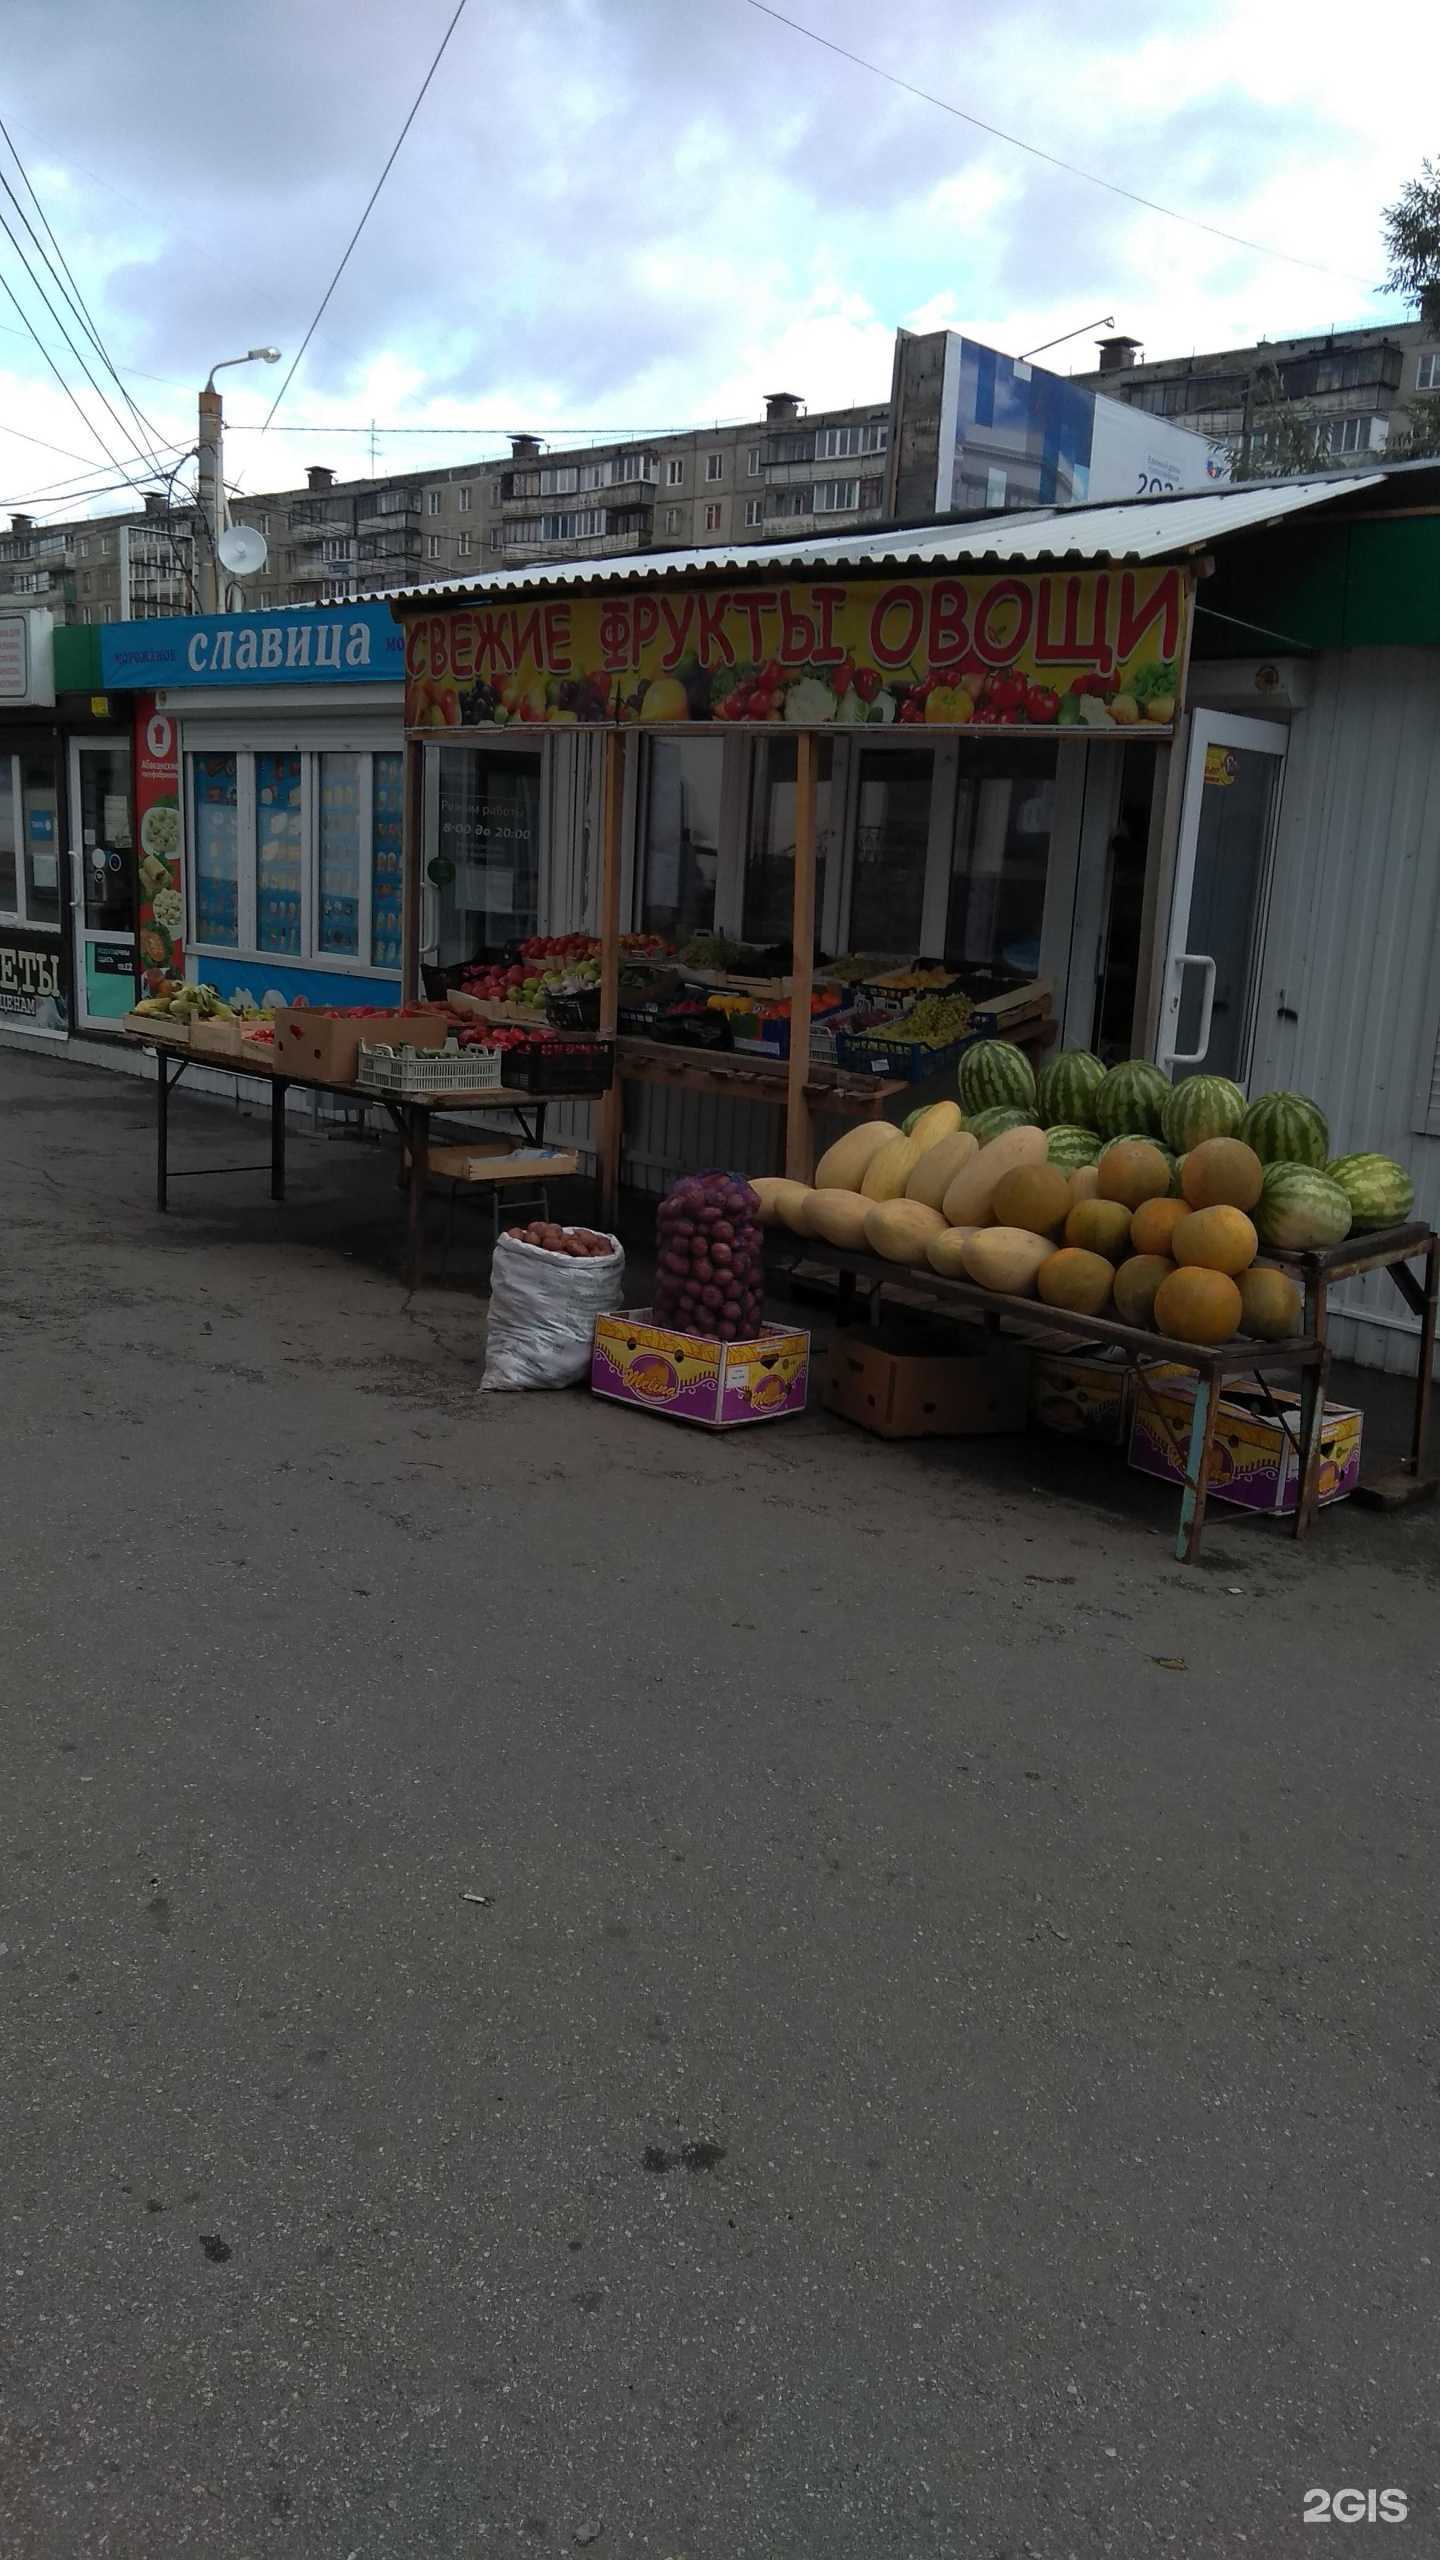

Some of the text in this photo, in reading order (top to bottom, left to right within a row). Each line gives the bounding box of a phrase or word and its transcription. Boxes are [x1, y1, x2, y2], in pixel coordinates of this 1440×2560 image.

[406, 568, 1180, 679] СВЕЖИЕ ФРУКТЫ ОВОЩИ
[495, 826, 531, 840] 20:00
